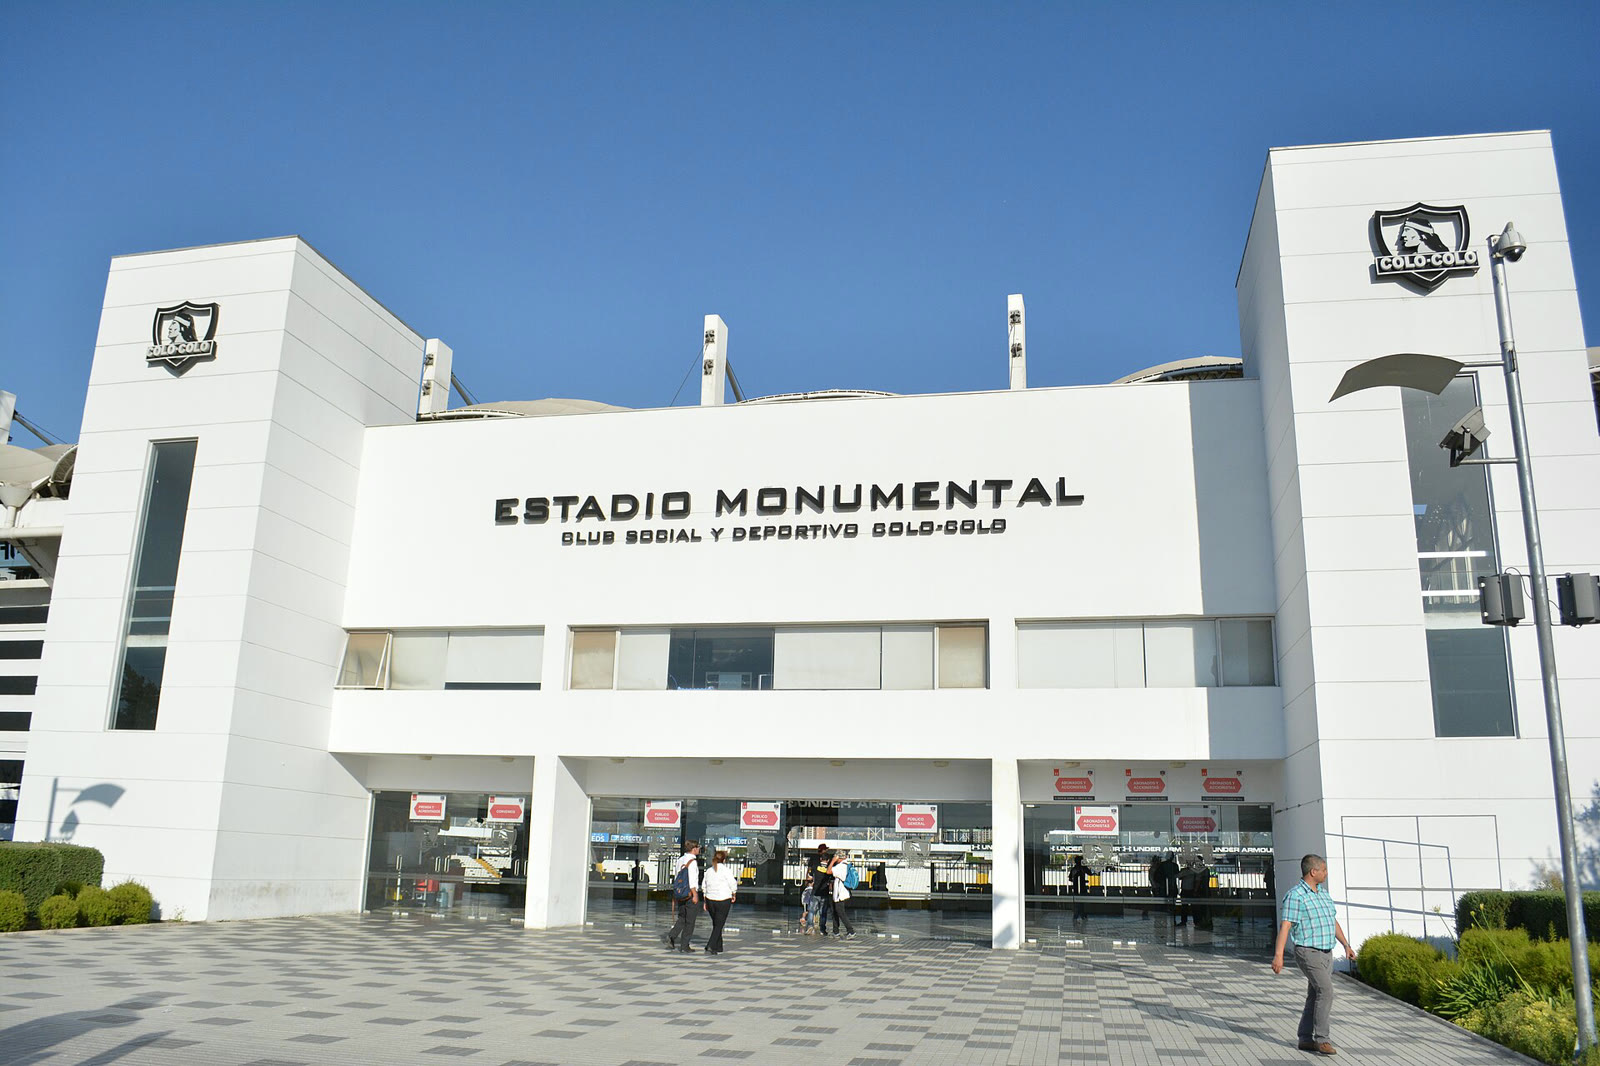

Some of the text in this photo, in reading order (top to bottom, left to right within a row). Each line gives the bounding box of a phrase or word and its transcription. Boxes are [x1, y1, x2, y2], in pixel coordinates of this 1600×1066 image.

[495, 477, 1085, 525] ESTADIO MONUMENTAL
[562, 519, 1006, 546] CLUB SOCIAL Y DEPORTIVO COLO-COLO
